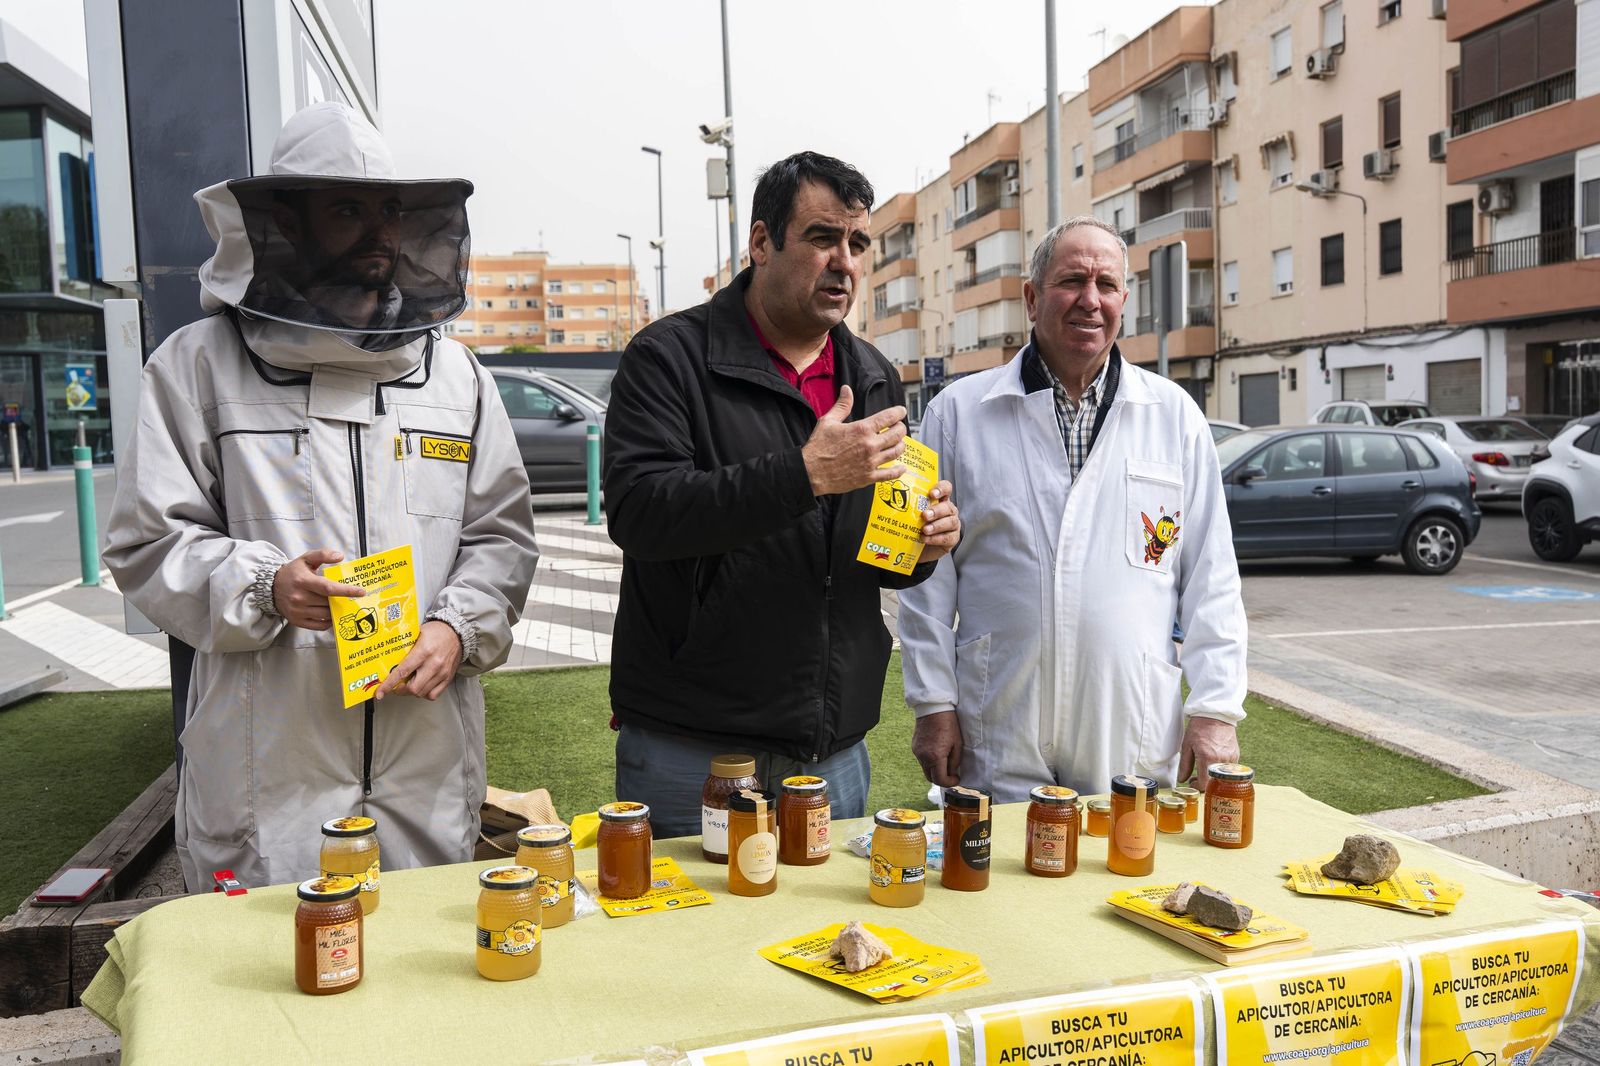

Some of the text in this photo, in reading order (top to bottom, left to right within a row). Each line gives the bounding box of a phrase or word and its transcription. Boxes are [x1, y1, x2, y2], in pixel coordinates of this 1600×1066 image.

[338, 560, 408, 584] PICULTOR/APICULTORA
[354, 562, 375, 573] BUSCA
[348, 649, 364, 660] HUYE
[374, 641, 385, 650] LAS
[386, 632, 413, 647] MEZCLAS
[363, 654, 380, 664] VERDAD
[391, 640, 416, 653] PROXIMIDA
[333, 935, 357, 947] FLORES
[1472, 951, 1529, 970] BUSCA TU
[1280, 976, 1346, 997] BUSCA TU
[1432, 963, 1568, 995] APICULTOR/APICULTORA
[1237, 991, 1393, 1023] APICULTOR/APICULTORA
[1465, 982, 1540, 1008] DE CERCANÍA:
[1051, 1011, 1128, 1035] BUSCA TU
[1274, 1012, 1362, 1038] DE CERCANÍA:
[1455, 1007, 1547, 1032] www.coag.org/apicultura
[785, 1046, 873, 1066] BUSCA TU
[999, 1026, 1184, 1064] APICULTOR/APICULTORA
[1263, 1038, 1370, 1063] www.coag.org/apicultura
